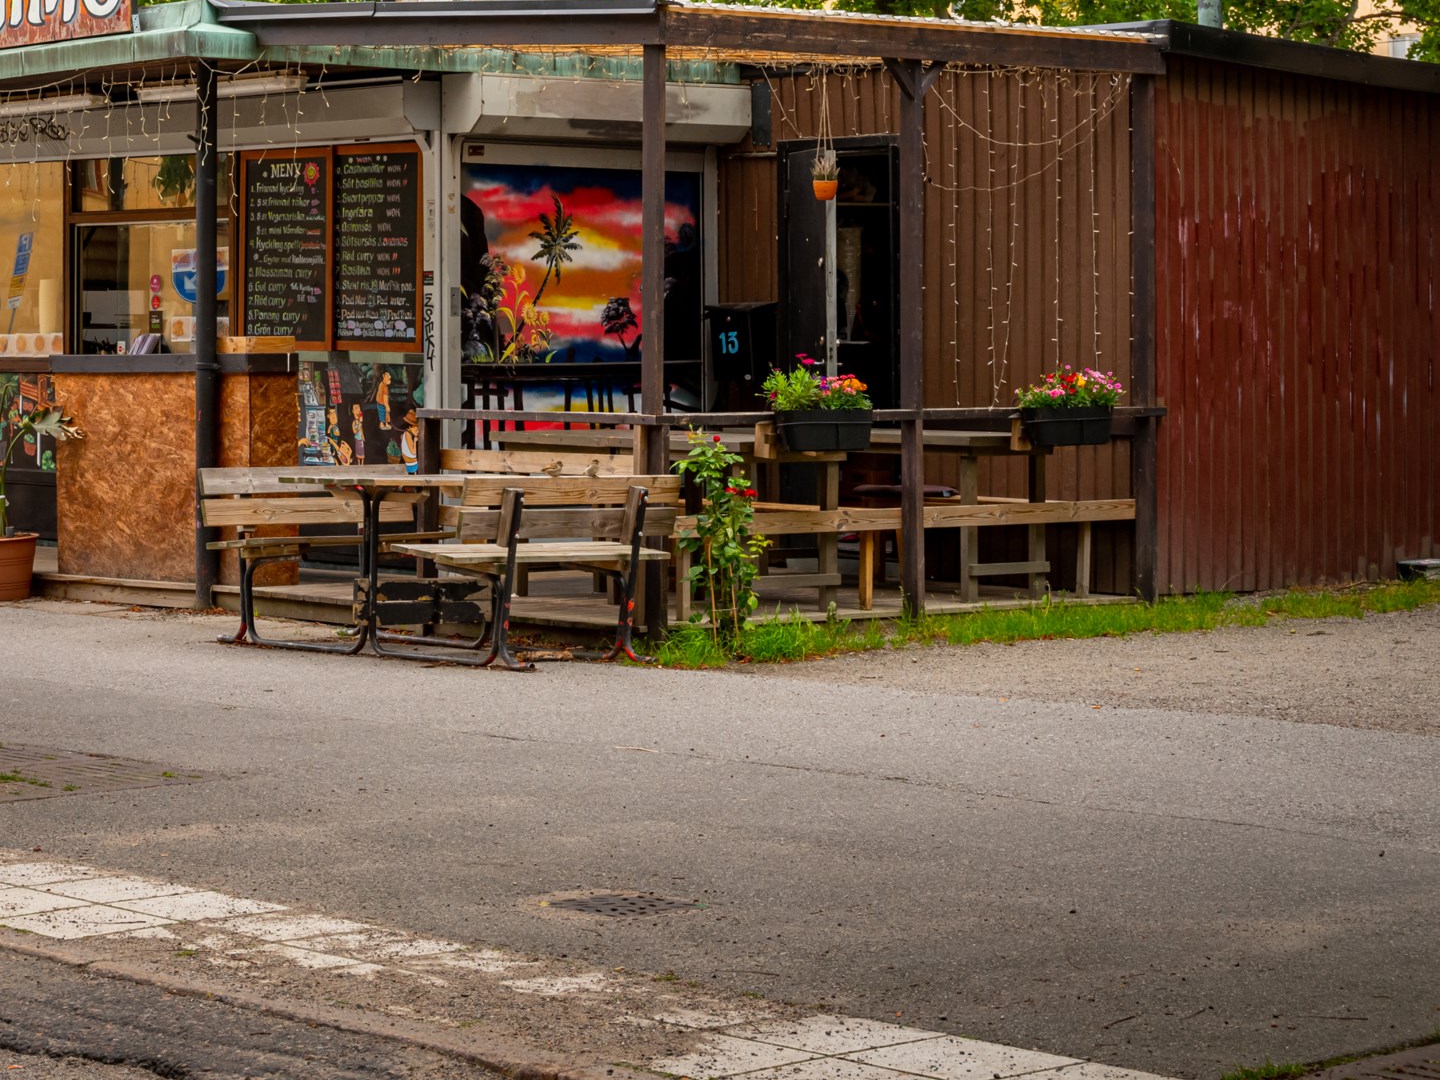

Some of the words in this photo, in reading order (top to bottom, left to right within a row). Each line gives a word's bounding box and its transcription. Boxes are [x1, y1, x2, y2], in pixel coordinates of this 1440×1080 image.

[270, 163, 301, 178] MENY
[282, 312, 301, 324] curry
[273, 325, 293, 336] curry
[719, 331, 739, 354] 13
